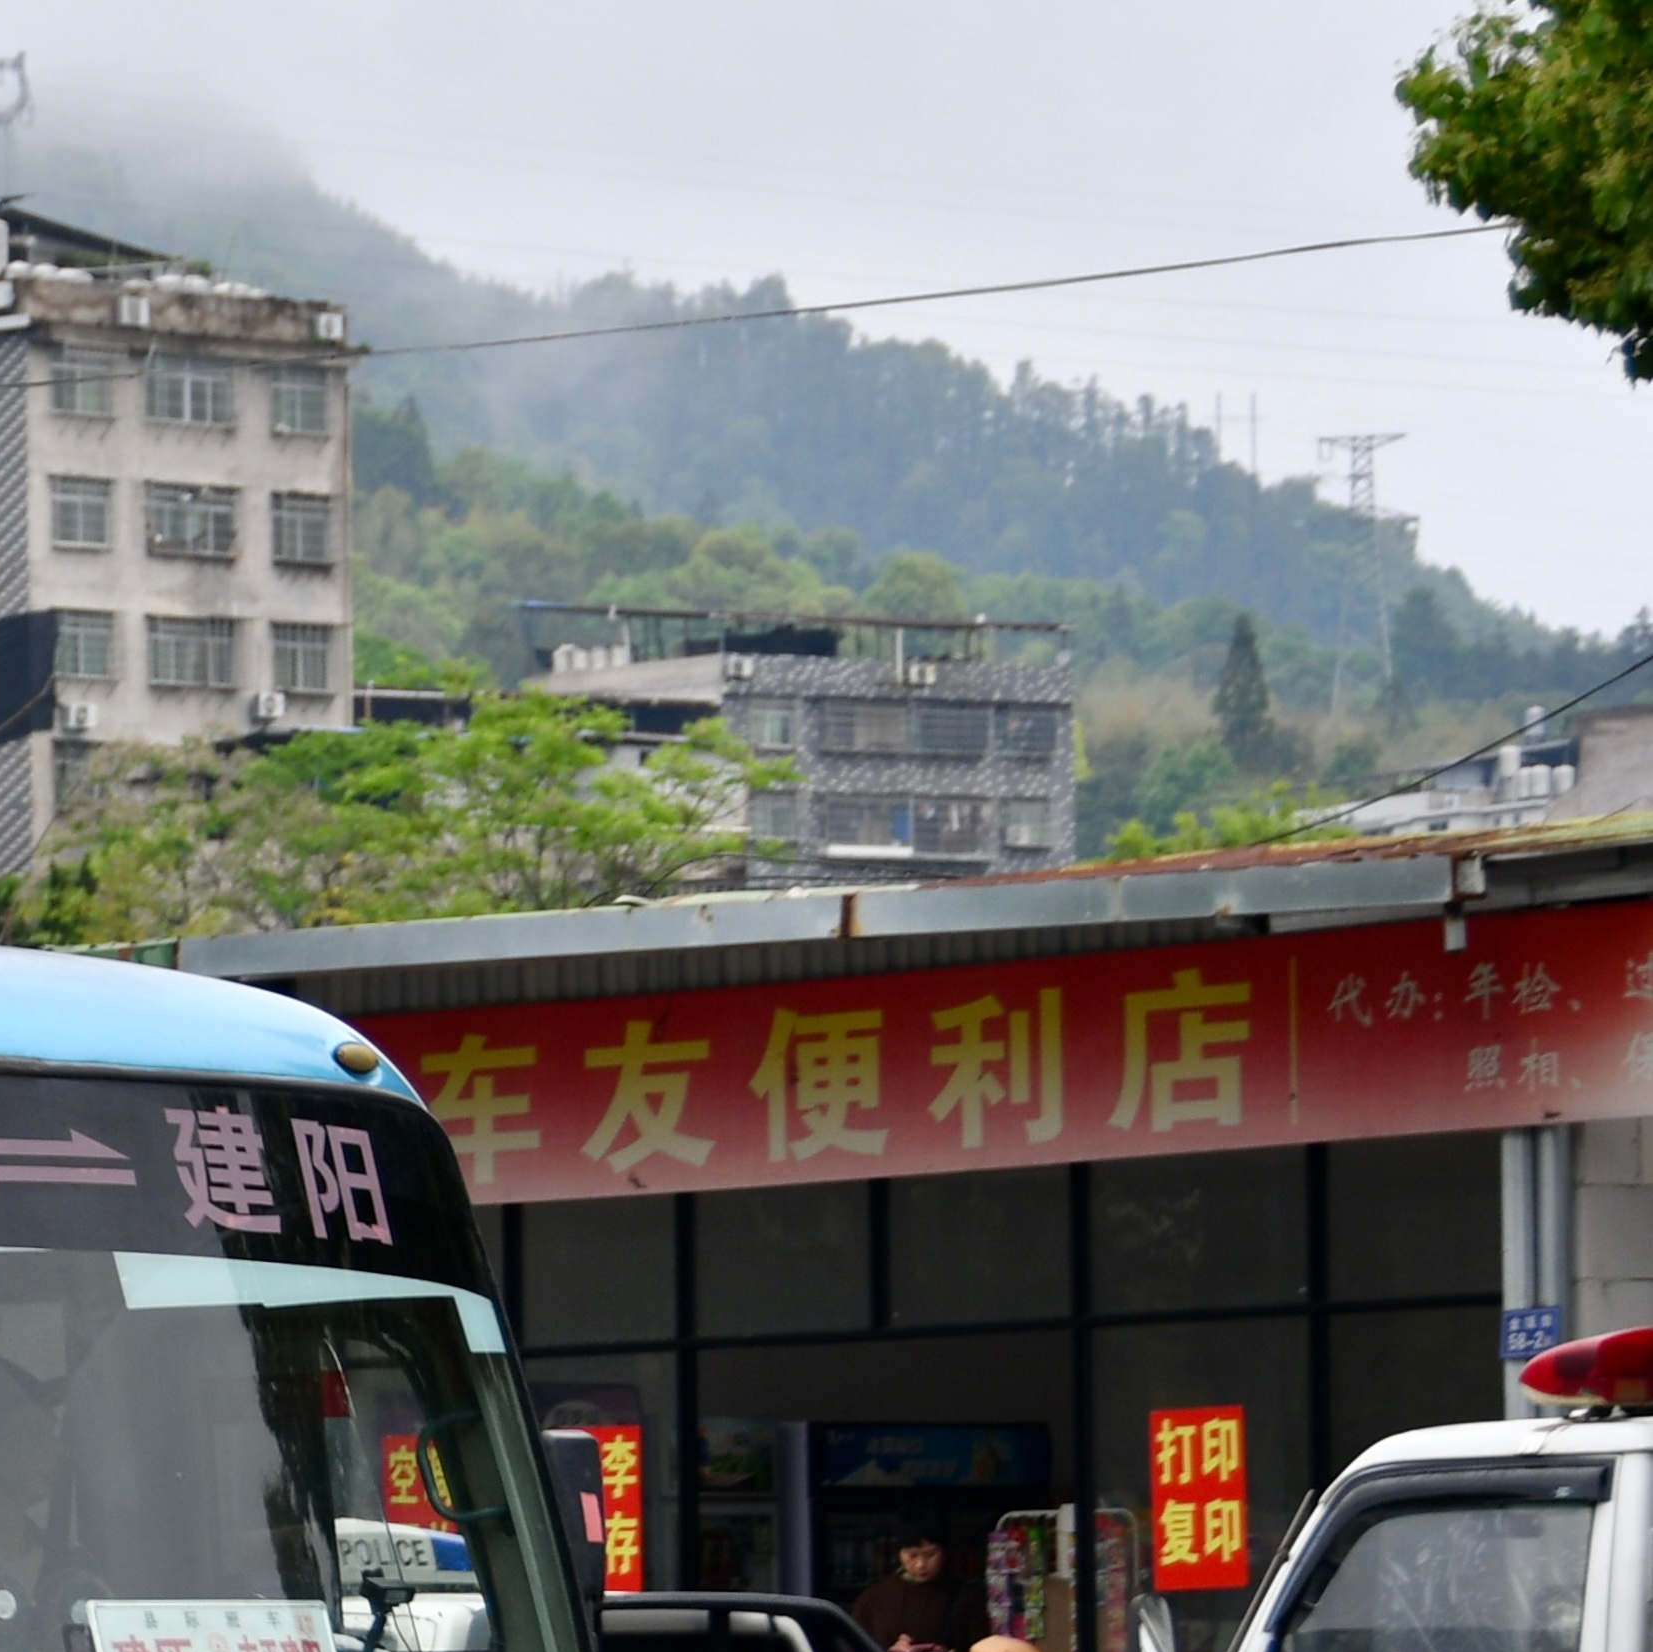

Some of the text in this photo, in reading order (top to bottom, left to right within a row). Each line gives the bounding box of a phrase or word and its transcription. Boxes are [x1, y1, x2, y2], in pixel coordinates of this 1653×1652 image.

[421, 968, 1251, 1185] 车友便利店
[164, 1106, 394, 1245] 建阳
[1155, 1416, 1241, 1485] 打印
[339, 1537, 429, 1567] POLICE
[1160, 1498, 1242, 1565] 复印
